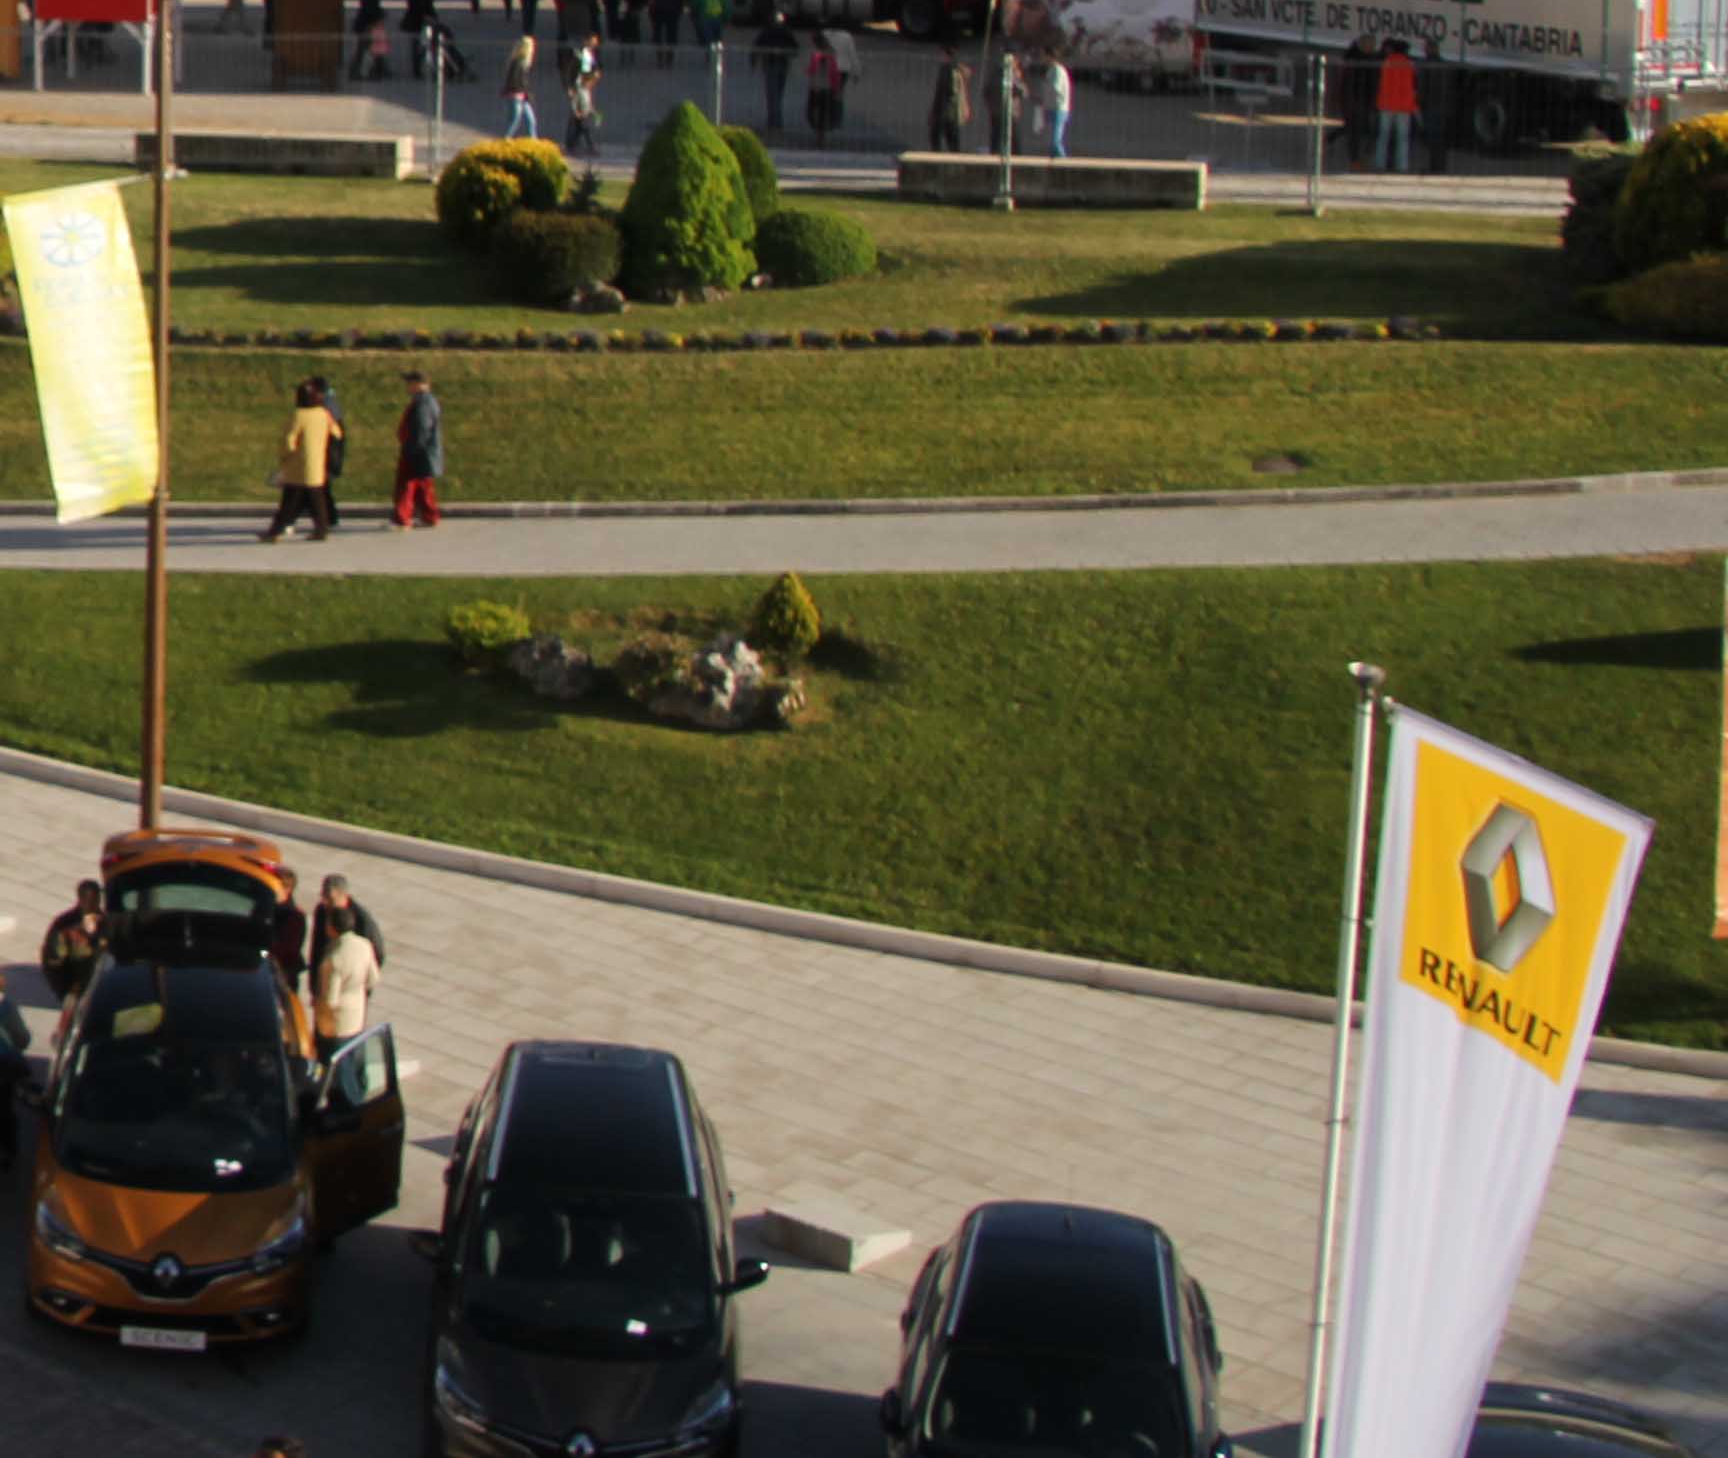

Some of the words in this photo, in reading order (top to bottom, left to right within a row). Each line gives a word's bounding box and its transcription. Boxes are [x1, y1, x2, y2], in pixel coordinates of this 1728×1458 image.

[1326, 3, 1350, 30] DE
[1356, 6, 1447, 41] TORANZO
[1463, 18, 1584, 57] CANTABRIA
[1418, 947, 1562, 1058] RENAULT
